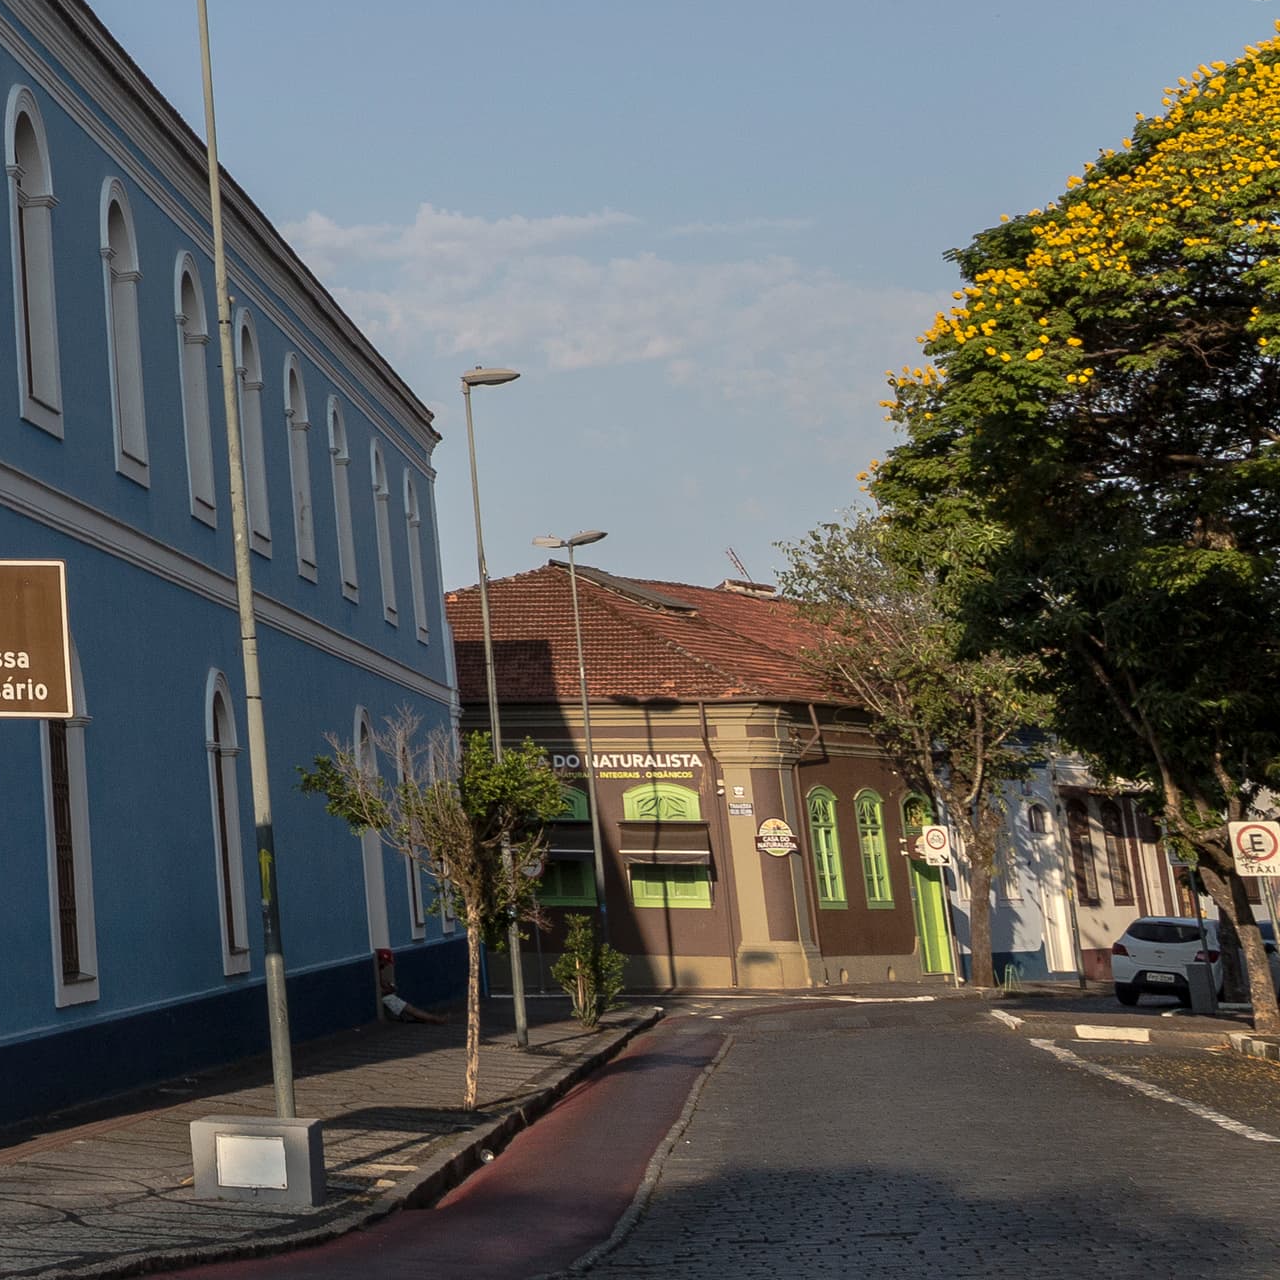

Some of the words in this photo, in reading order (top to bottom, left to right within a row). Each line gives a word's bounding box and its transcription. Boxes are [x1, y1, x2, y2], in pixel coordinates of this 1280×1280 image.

[553, 754, 580, 768] DO
[585, 753, 702, 768] NATURALISTA
[599, 771, 640, 779] INTEGRAIS
[645, 770, 693, 779] ORGÂNICOS
[1249, 834, 1265, 852] E
